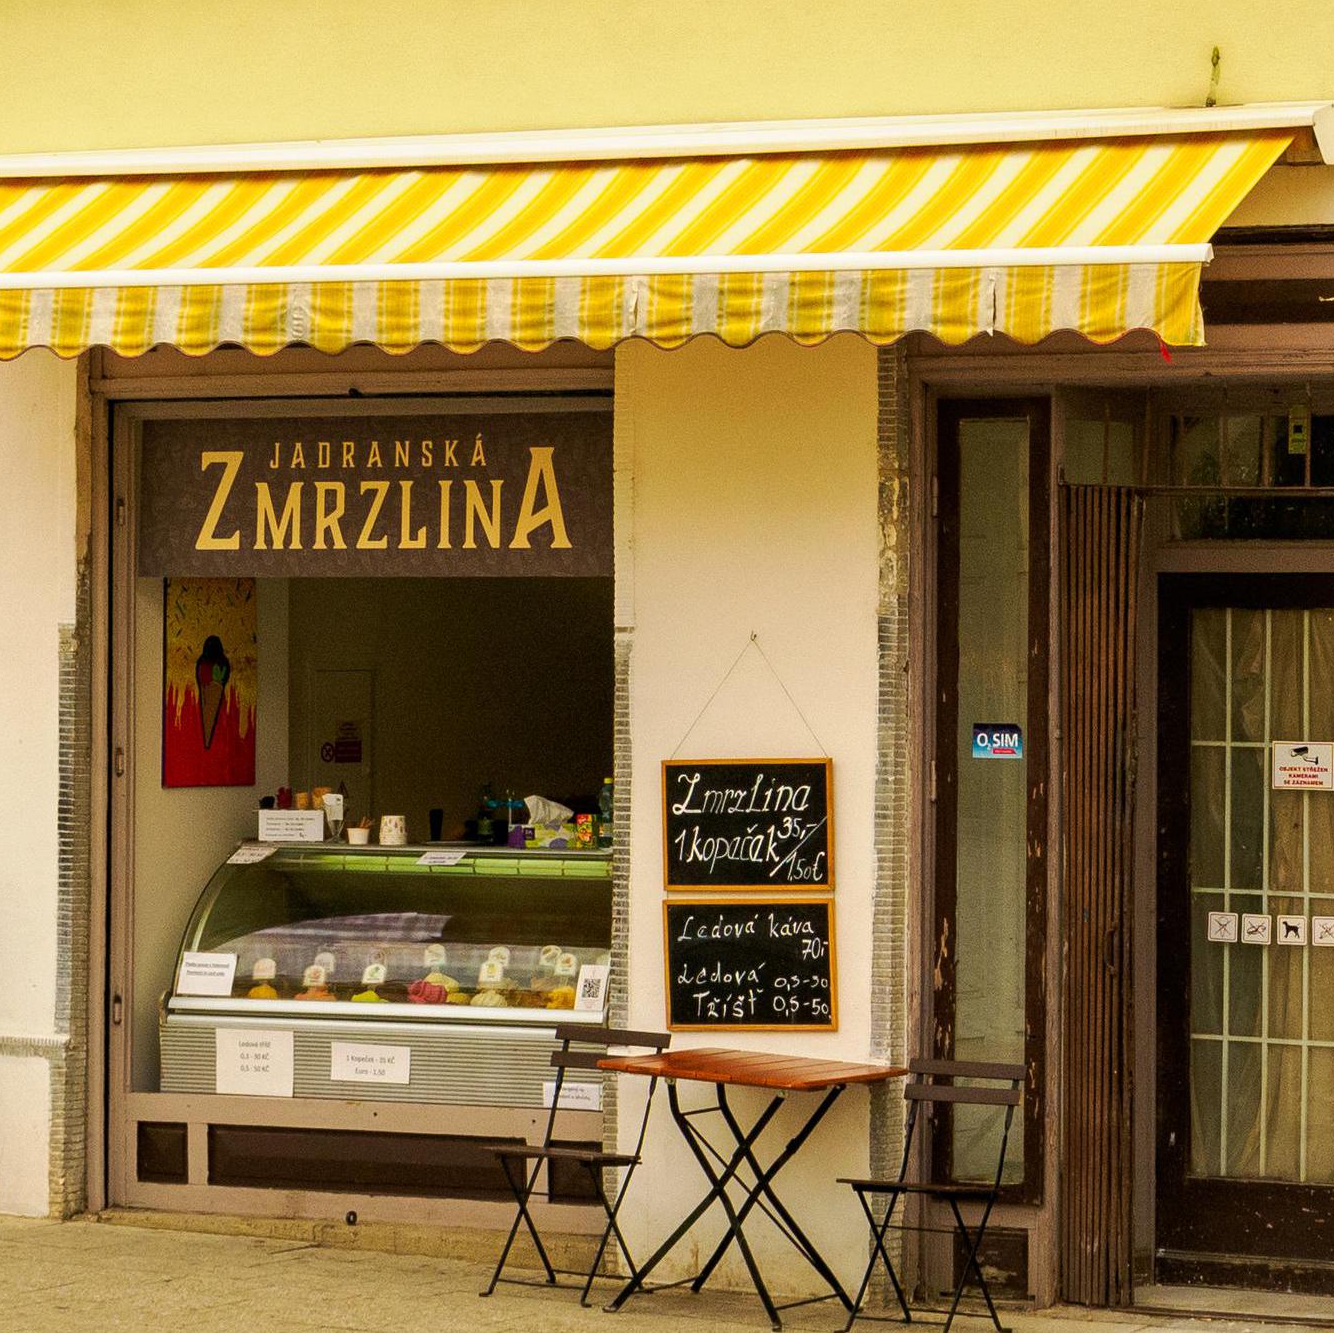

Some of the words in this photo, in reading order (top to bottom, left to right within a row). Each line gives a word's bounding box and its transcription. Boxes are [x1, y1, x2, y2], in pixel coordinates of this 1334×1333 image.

[270, 433, 487, 468] JADRANSKÁ
[195, 446, 572, 550] ZMRZLINA
[992, 733, 1019, 748] SIM
[677, 914, 759, 941] Ledová
[768, 913, 814, 938] káva
[677, 961, 766, 985] Ledová
